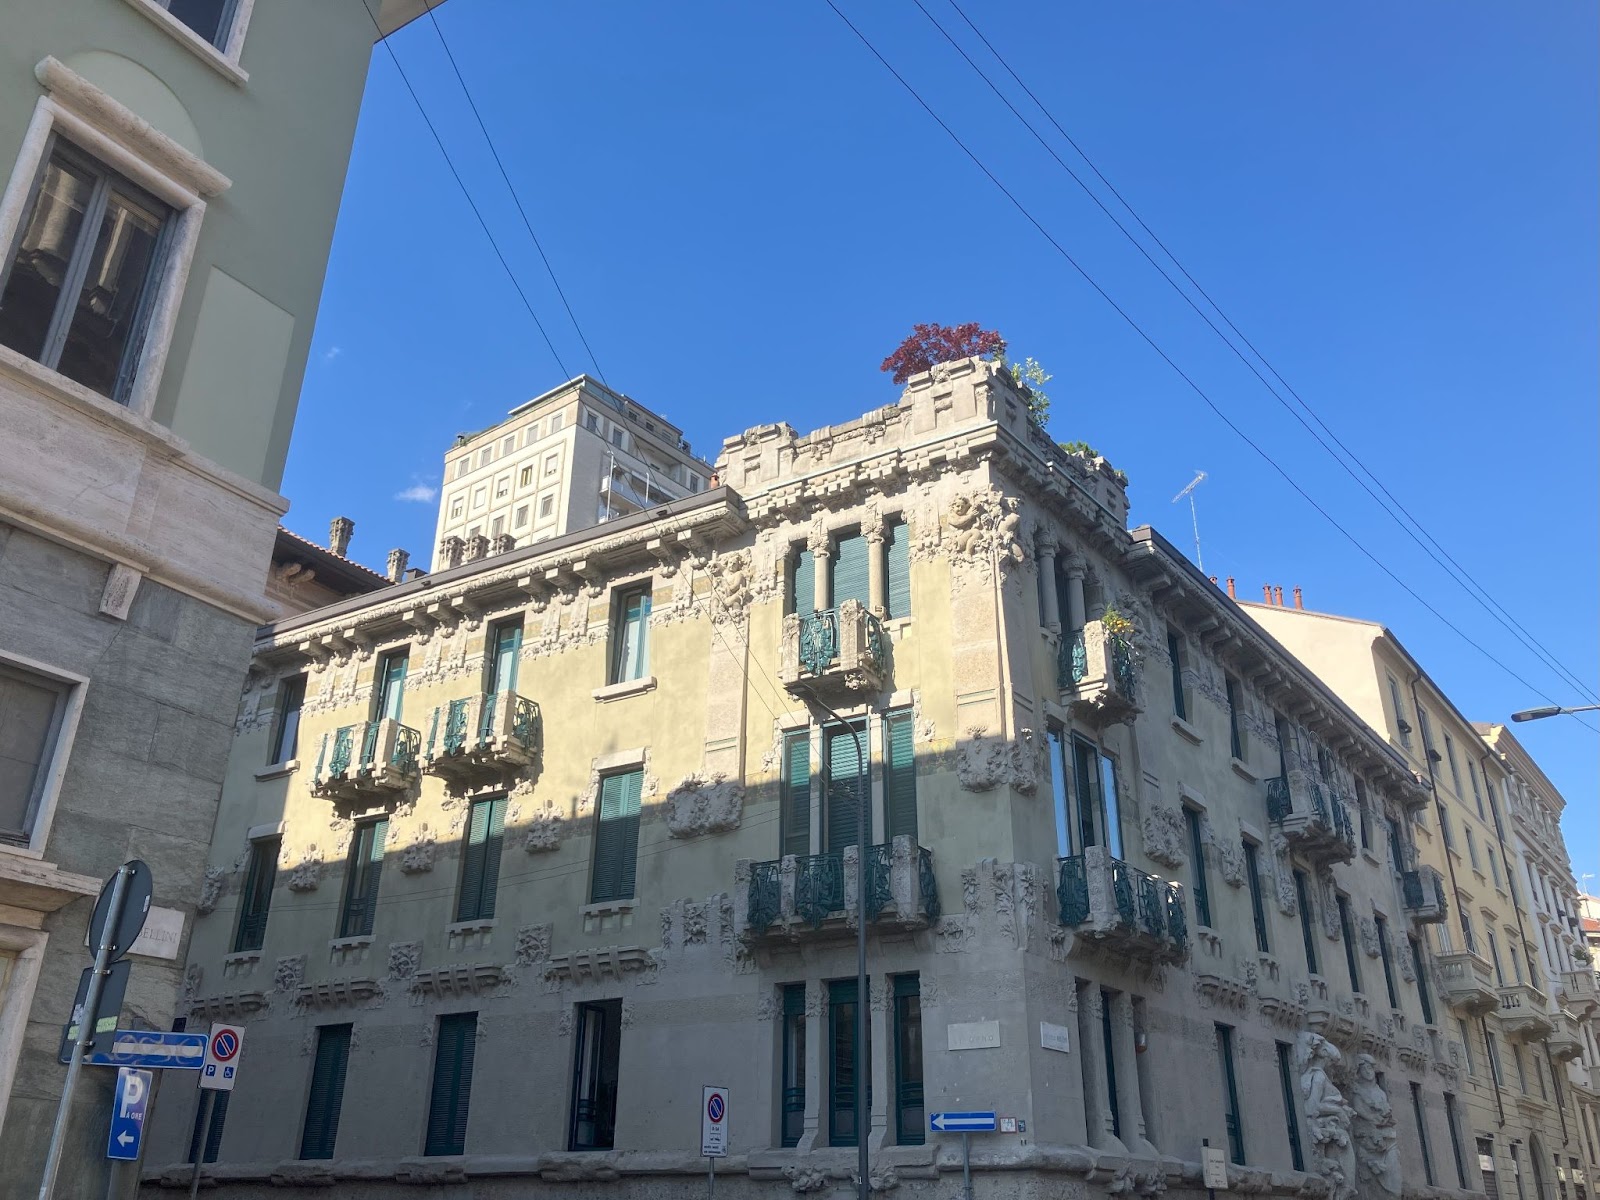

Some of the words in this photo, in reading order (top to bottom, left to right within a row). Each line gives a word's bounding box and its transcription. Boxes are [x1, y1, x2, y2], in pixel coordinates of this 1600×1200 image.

[207, 1065, 214, 1075] P
[119, 1074, 143, 1118] P
[125, 1111, 130, 1119] A
[130, 1112, 143, 1120] ORE
